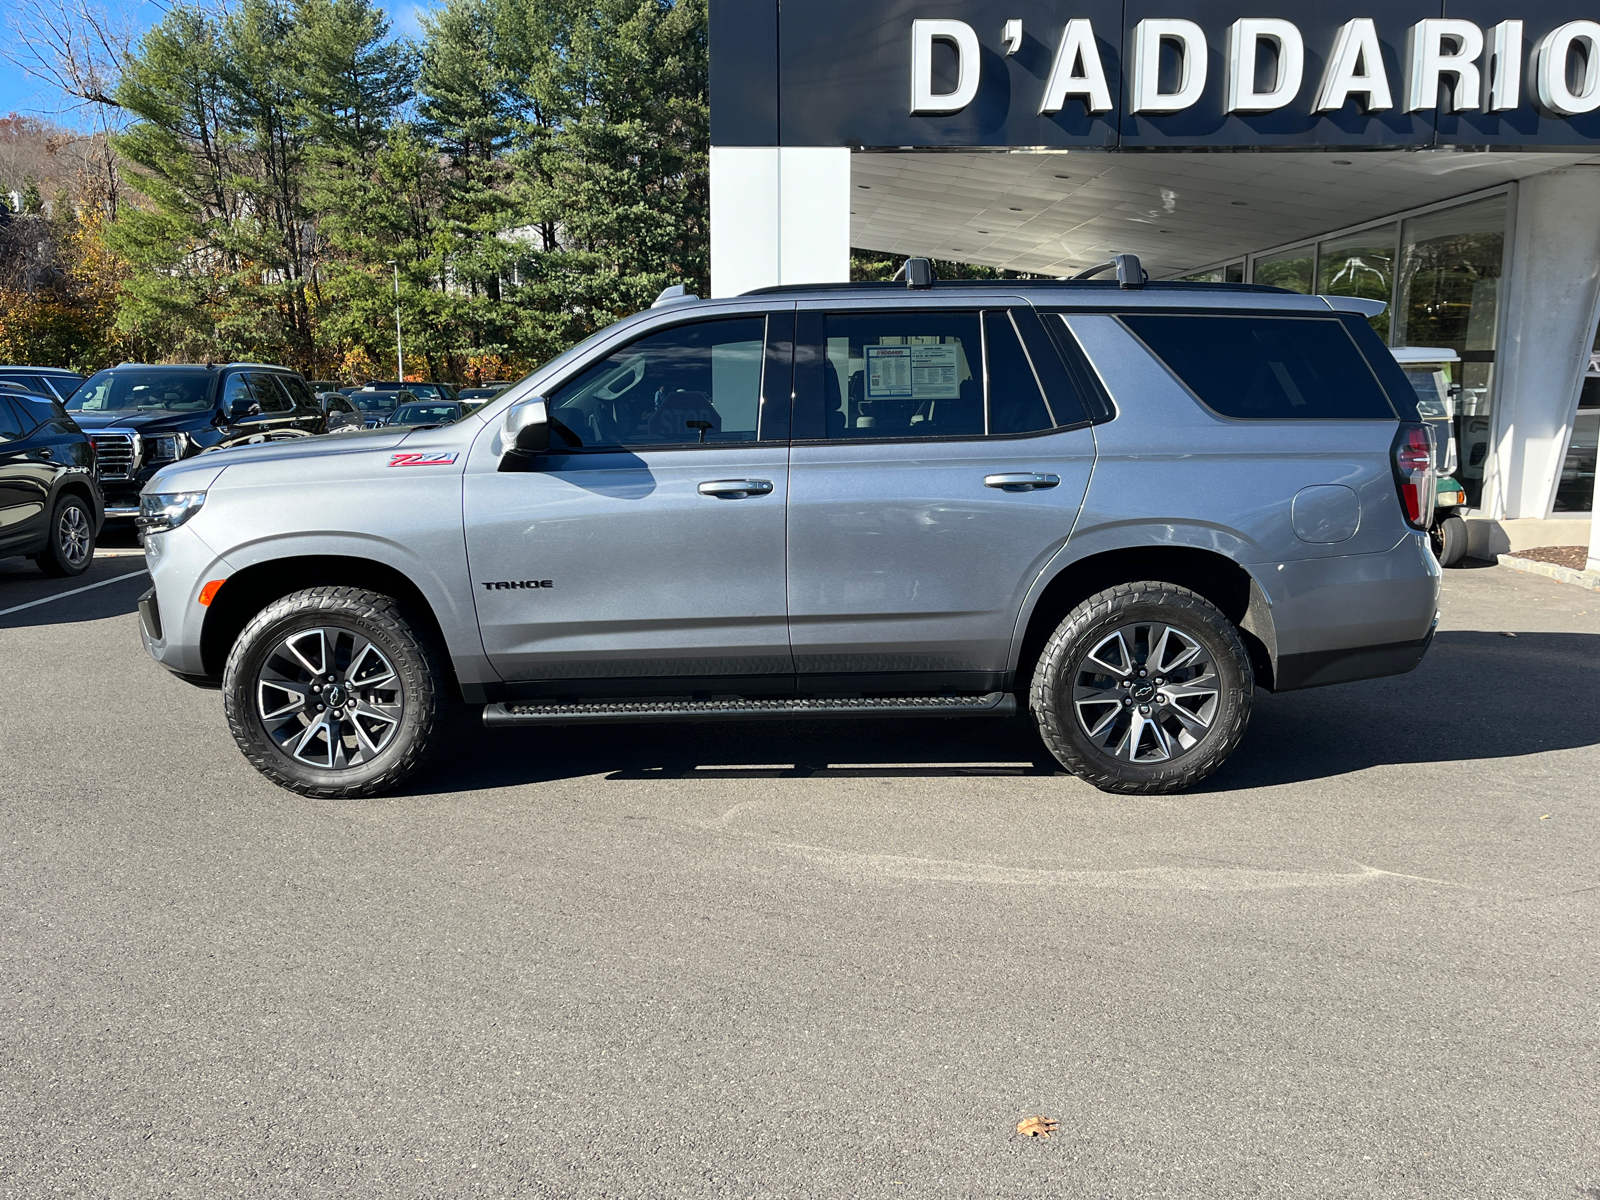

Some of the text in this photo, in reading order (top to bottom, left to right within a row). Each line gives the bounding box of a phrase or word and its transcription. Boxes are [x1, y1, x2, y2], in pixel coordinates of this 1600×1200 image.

[909, 18, 1600, 115] D'ADDARIO
[386, 452, 460, 467] Z71
[481, 580, 554, 591] TAHOE
[1224, 687, 1238, 724] RECON
